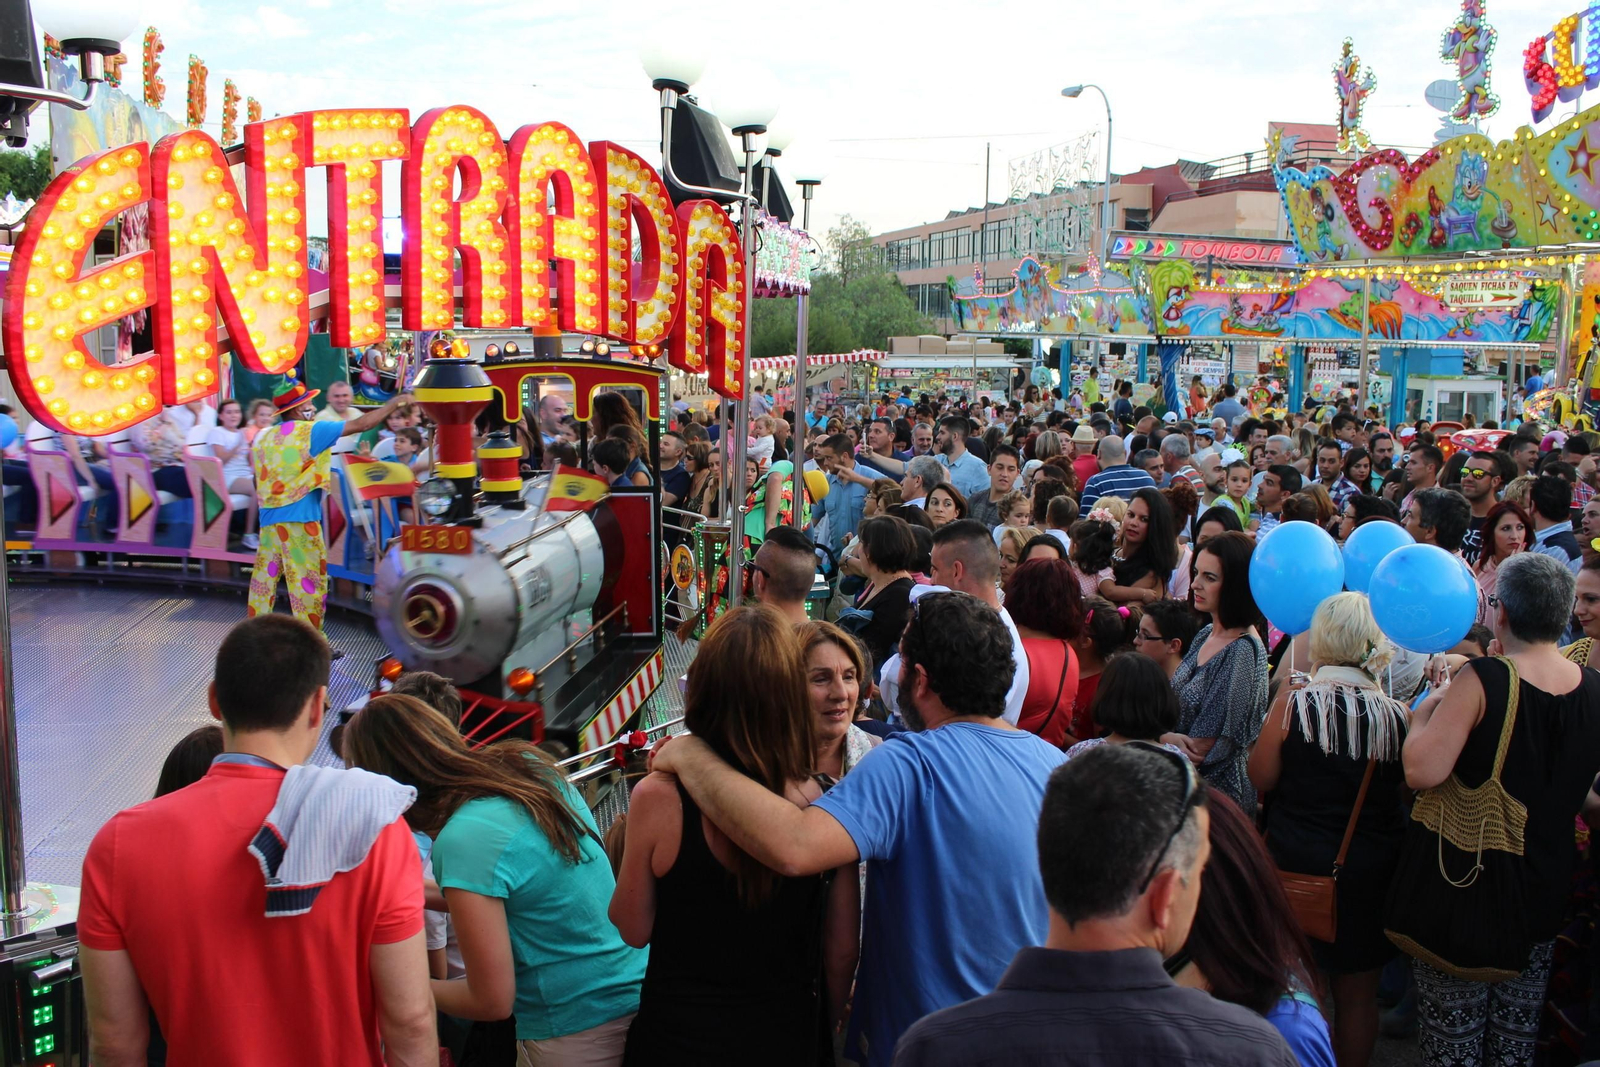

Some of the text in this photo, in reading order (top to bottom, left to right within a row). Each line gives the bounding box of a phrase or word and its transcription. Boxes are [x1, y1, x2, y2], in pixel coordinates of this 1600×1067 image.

[1181, 241, 1282, 262] TOMBOLA
[7, 105, 746, 436] ENTRADA
[1450, 281, 1518, 293] SAQUEN FICHAS EN
[1449, 294, 1484, 305] TAQUILLA
[404, 529, 468, 550] 1580
